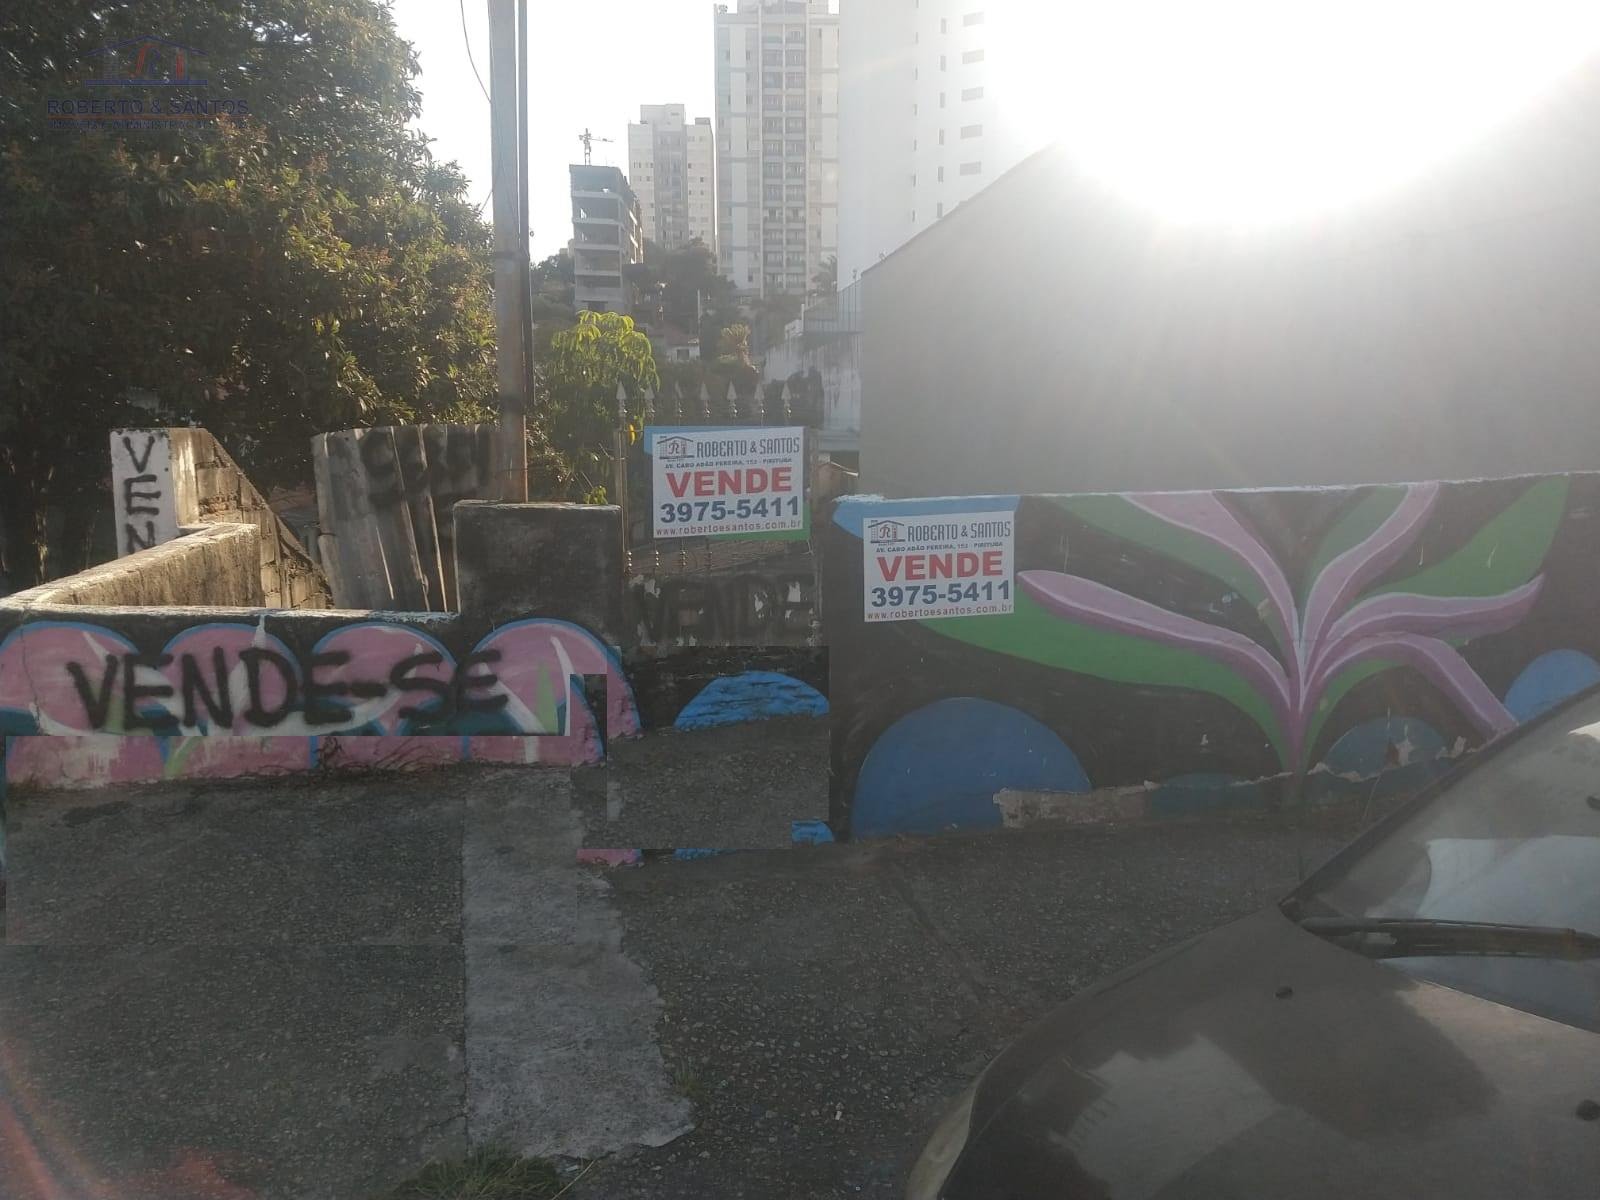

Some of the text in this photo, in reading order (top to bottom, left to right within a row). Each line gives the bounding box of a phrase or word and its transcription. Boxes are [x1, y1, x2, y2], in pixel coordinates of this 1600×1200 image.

[697, 437, 800, 458] ROBERTO & SANTOS
[666, 467, 792, 498] VENDE
[660, 496, 799, 523] 3975-5411
[656, 520, 801, 535] www.robertoesantos.com.br
[907, 521, 1011, 542] ROBERTO & SANTOS
[876, 551, 1003, 582] VENDE
[871, 580, 1009, 607] 3975-5411
[867, 604, 1013, 620] www.robertoesantos.com.br
